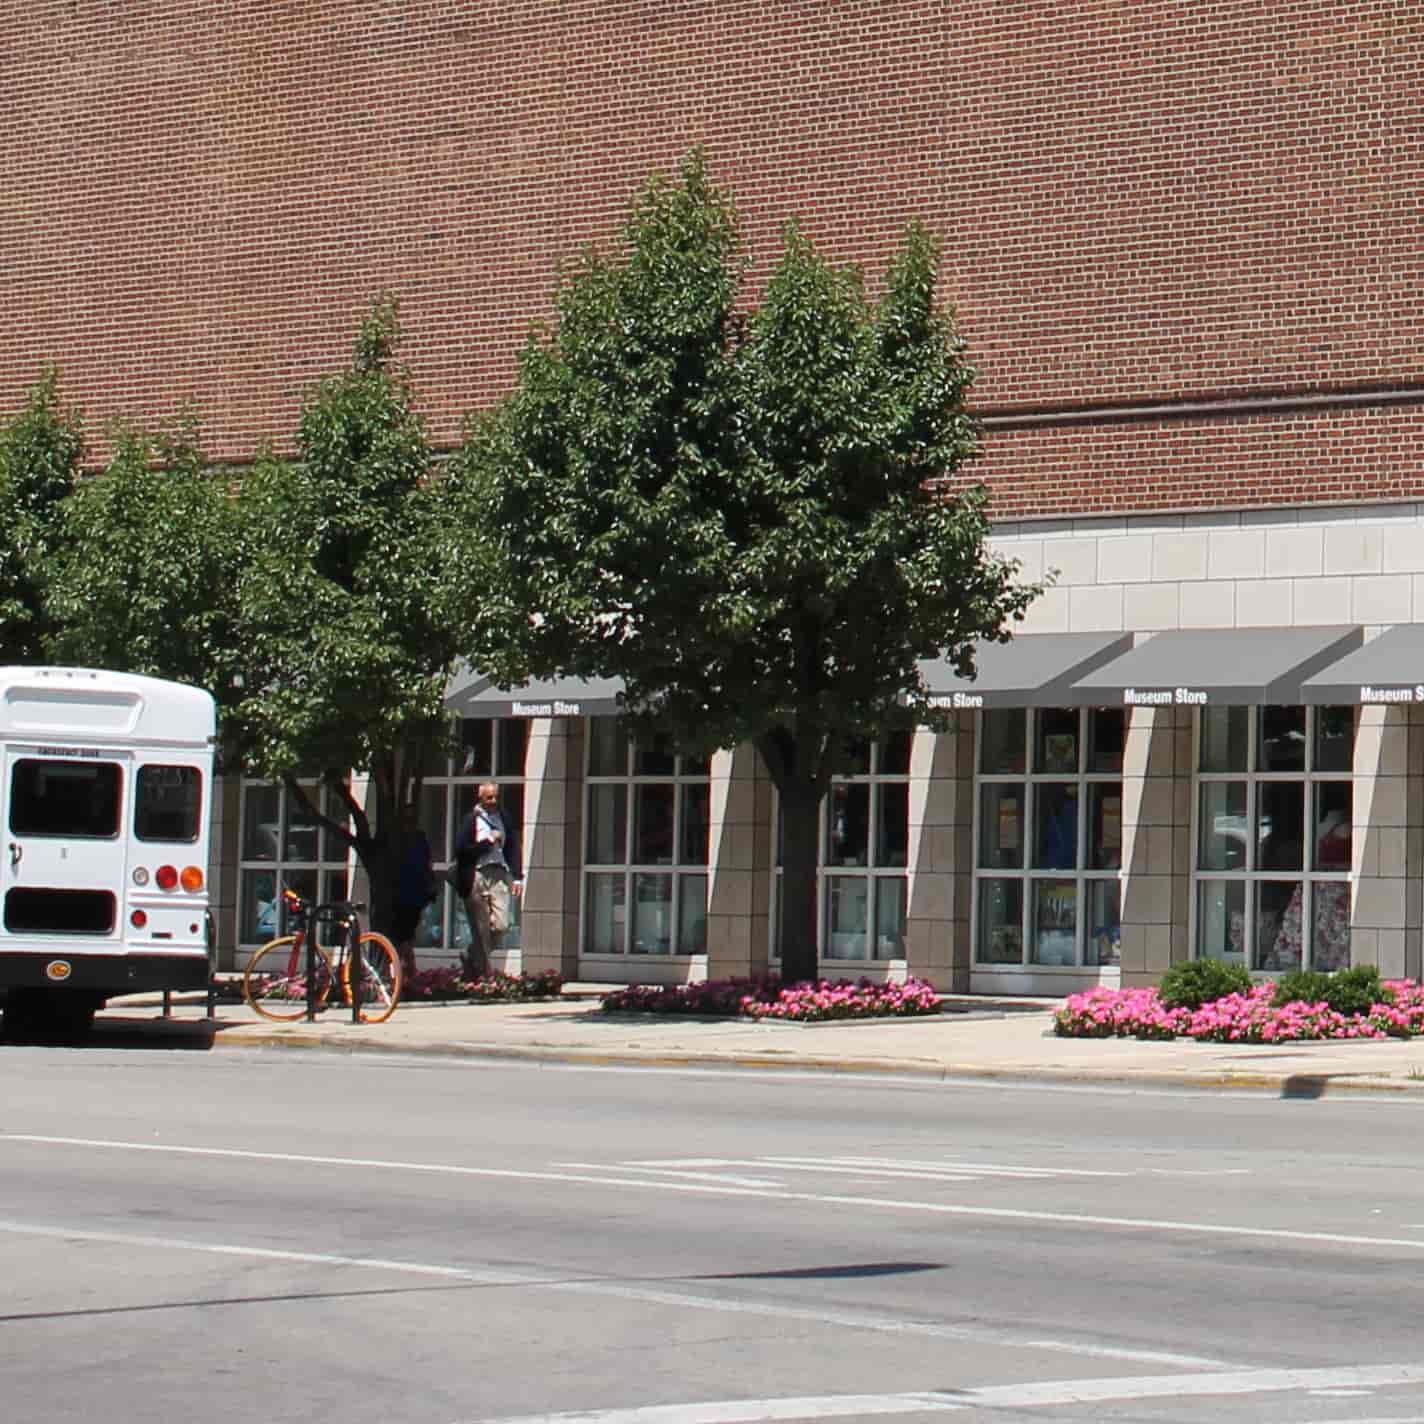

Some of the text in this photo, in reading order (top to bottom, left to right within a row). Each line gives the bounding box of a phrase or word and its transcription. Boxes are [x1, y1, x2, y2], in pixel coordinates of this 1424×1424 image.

[953, 692, 983, 708] Store
[1124, 687, 1208, 704] Museum Store
[1360, 686, 1412, 702] Museum
[512, 701, 580, 716] Museum Store
